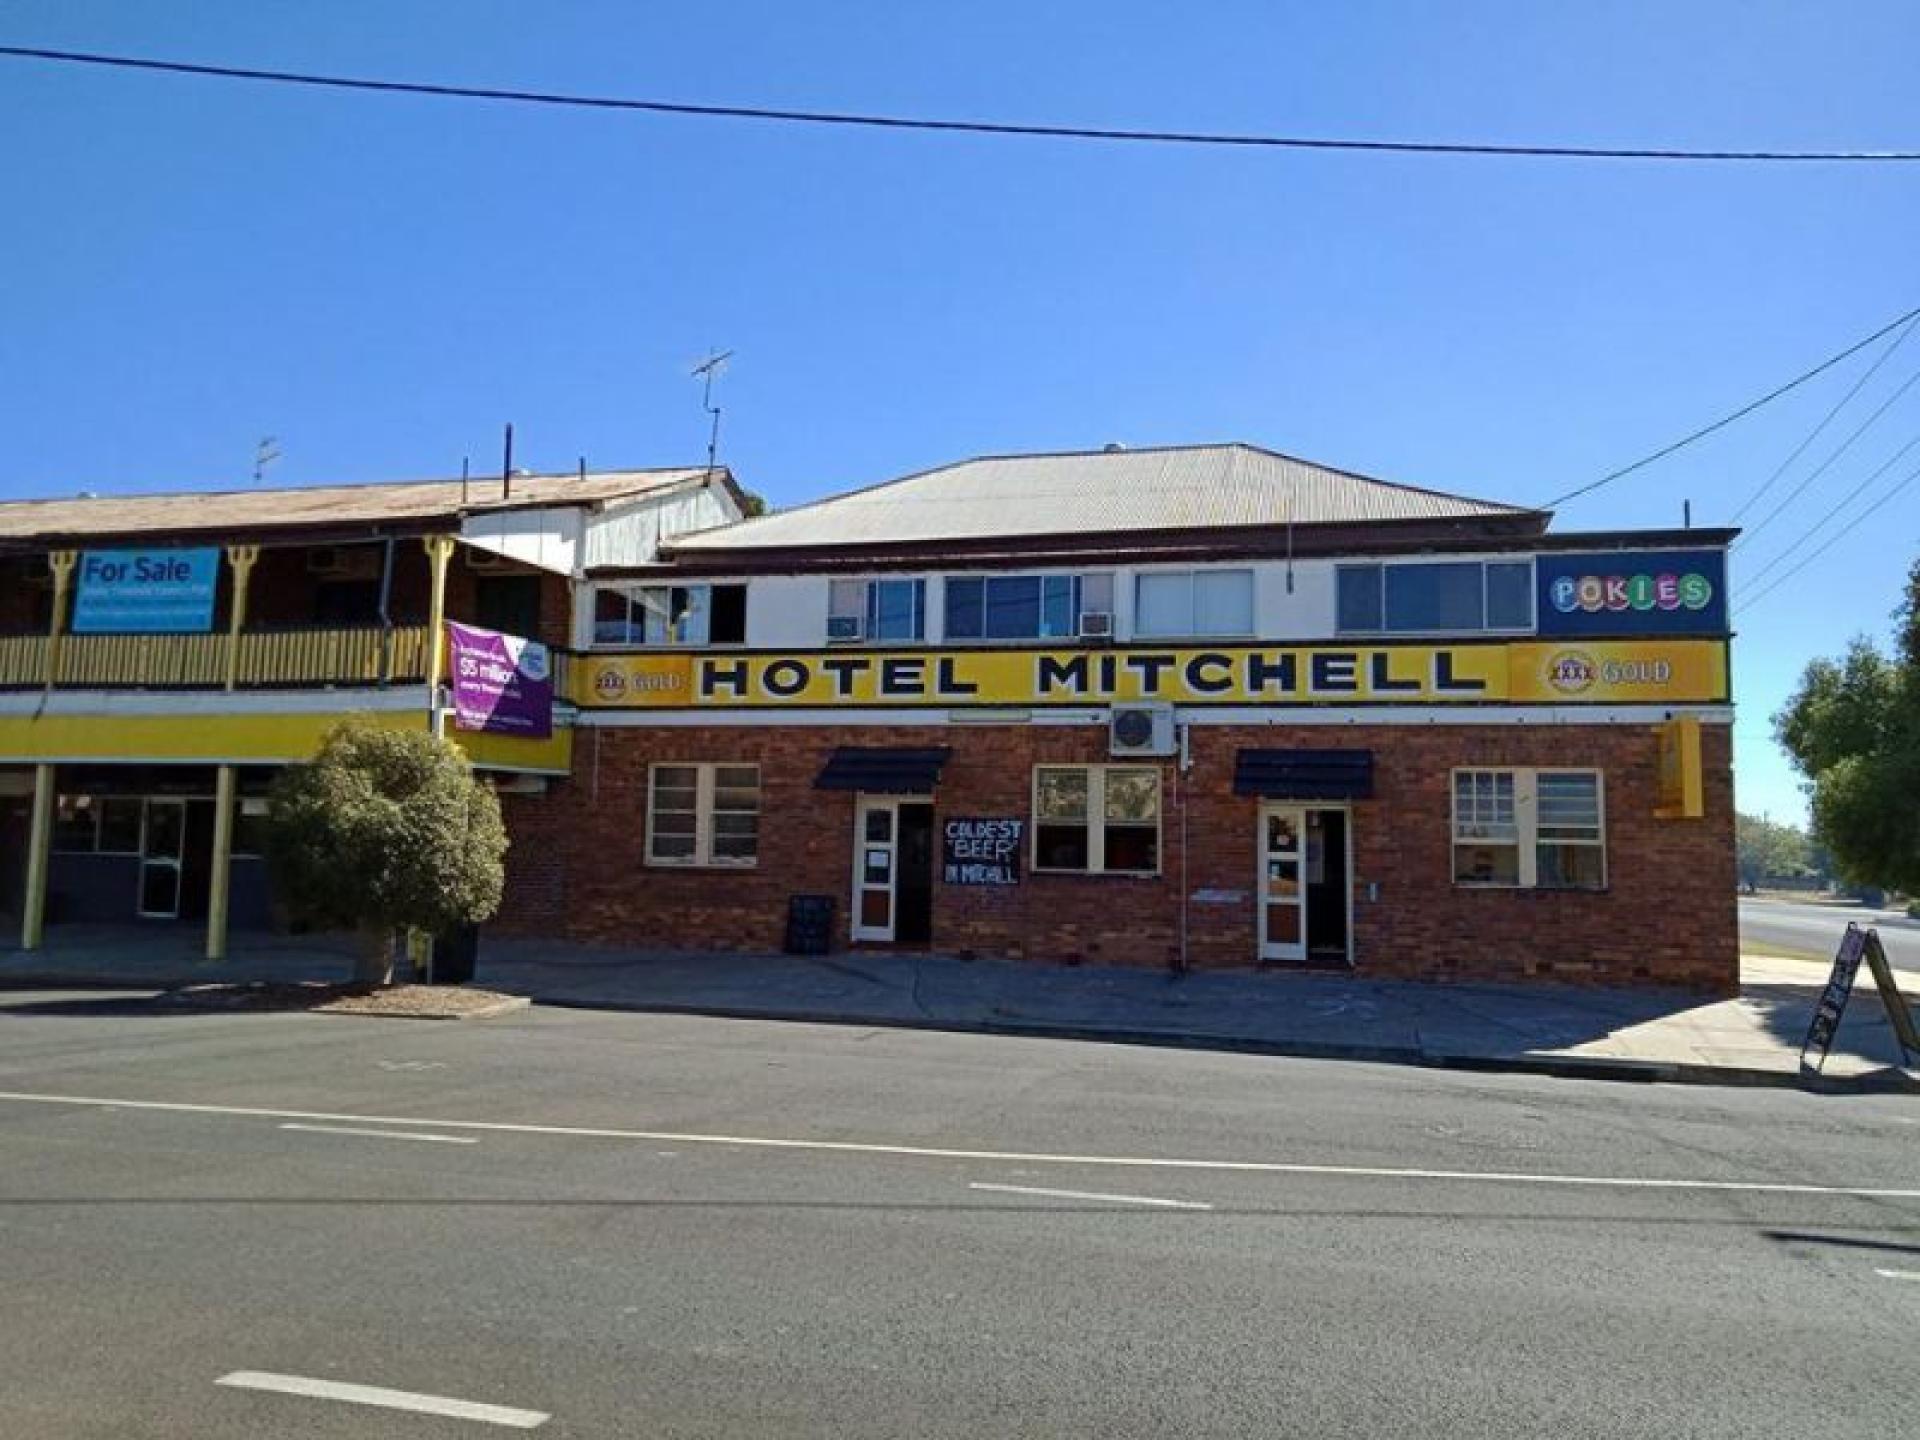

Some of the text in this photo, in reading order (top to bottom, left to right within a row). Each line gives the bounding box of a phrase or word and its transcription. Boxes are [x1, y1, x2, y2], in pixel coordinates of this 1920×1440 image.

[85, 556, 191, 582] For Sale
[1555, 579, 1704, 604] POKIES
[701, 652, 1487, 697] HOTEL MITCHELL
[1549, 660, 1672, 685] XXXX GOLD
